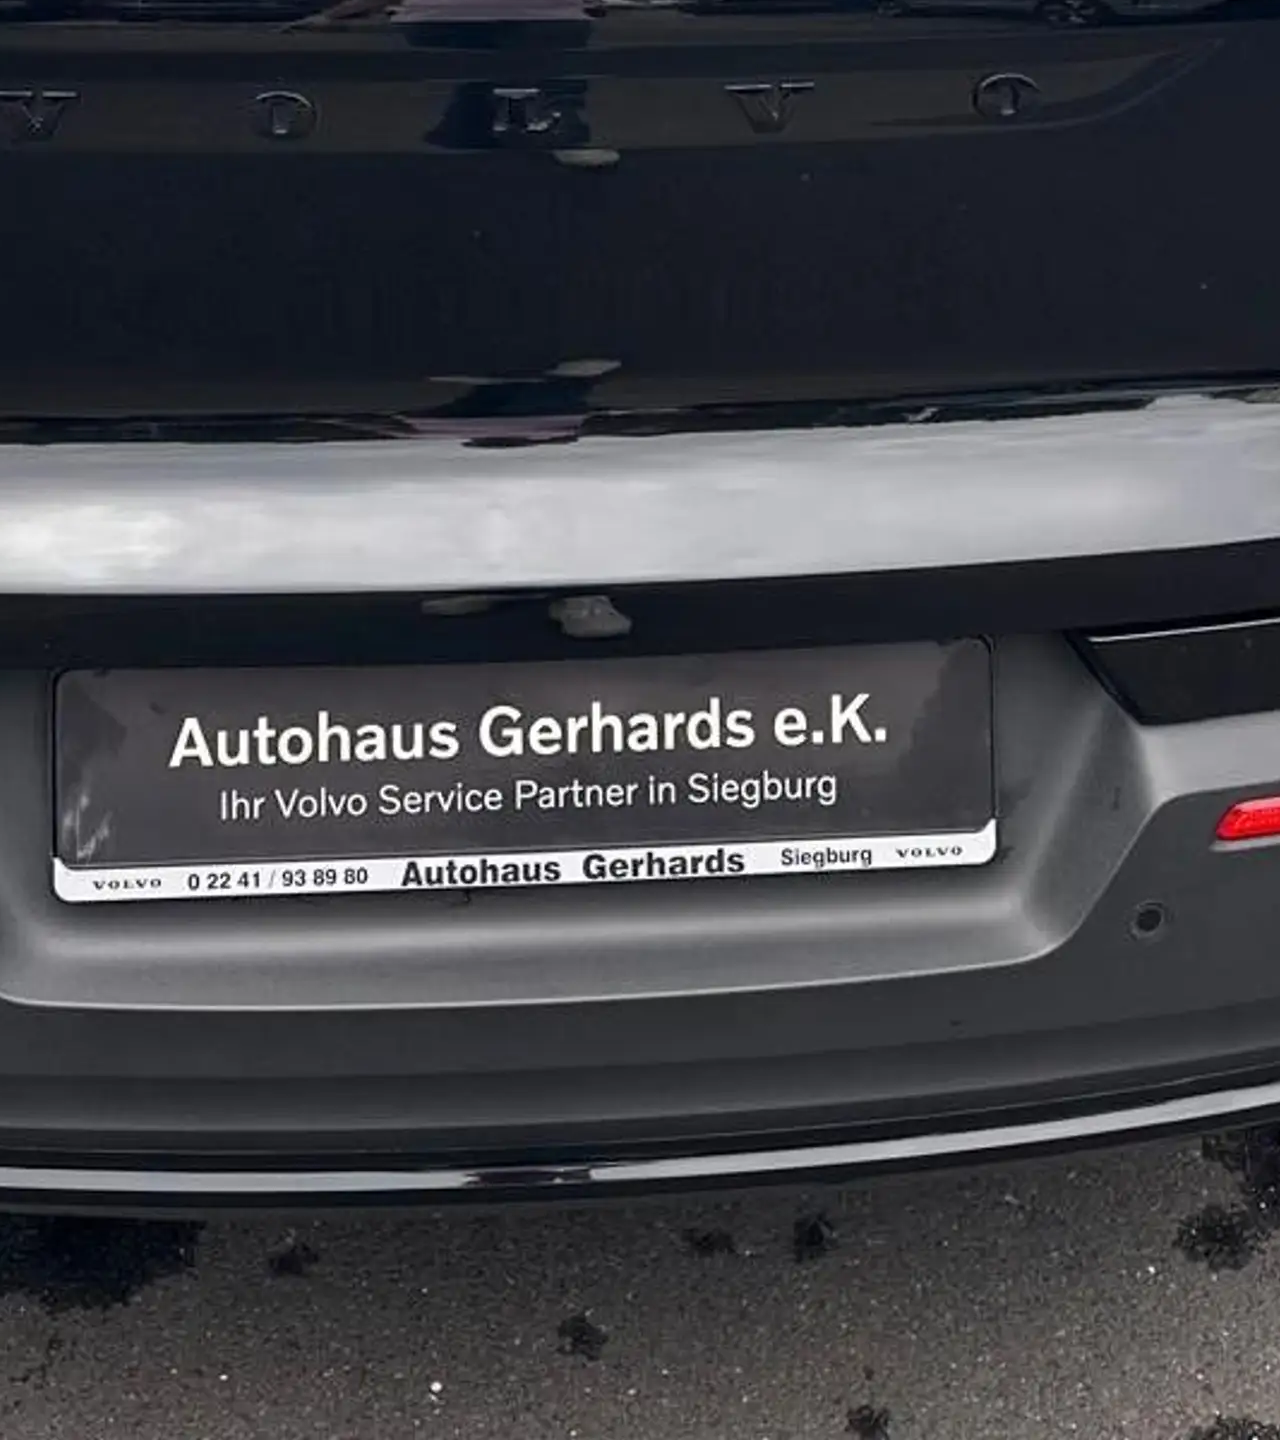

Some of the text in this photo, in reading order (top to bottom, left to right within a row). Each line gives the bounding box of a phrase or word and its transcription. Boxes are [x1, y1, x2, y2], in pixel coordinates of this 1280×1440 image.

[168, 692, 888, 768] Autohaus Gerhards e.K.
[219, 770, 838, 822] Ihr Volvo Service Partner in Siegburg
[92, 877, 163, 891] VOLVO
[187, 872, 200, 890] 0
[207, 872, 231, 890] 22
[237, 871, 261, 888] 41
[282, 869, 307, 887] 93
[313, 868, 338, 886] 89
[344, 868, 369, 885] 80
[401, 854, 562, 888] Autohaus
[581, 848, 746, 881] Gerhards
[780, 846, 873, 869] Siegburg
[895, 845, 964, 859] VOLVO
